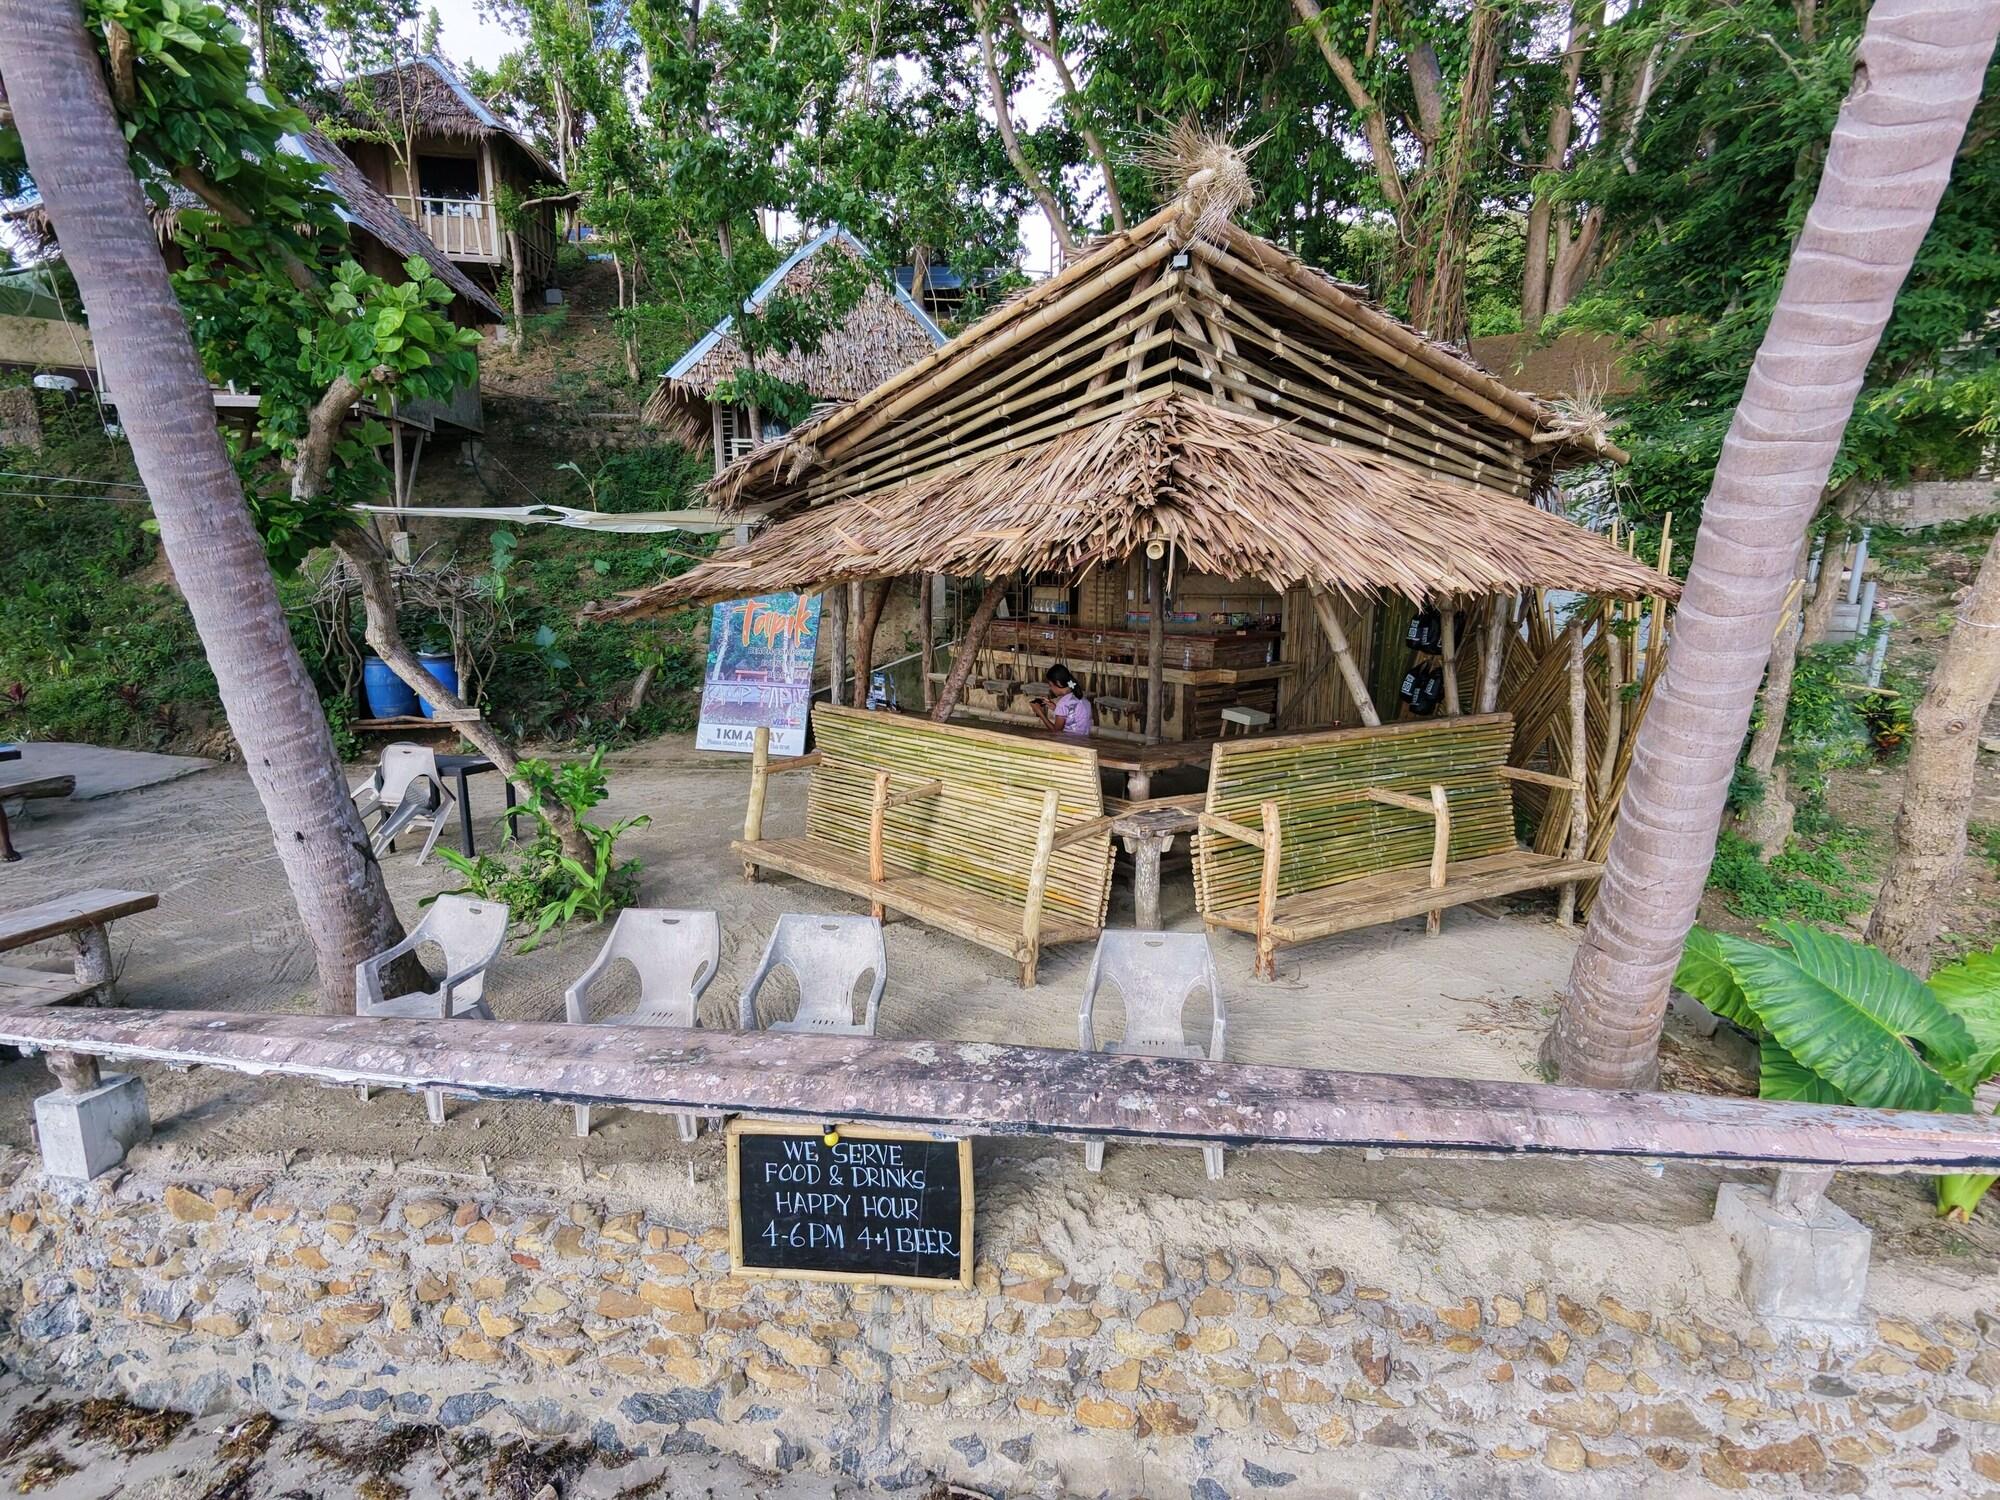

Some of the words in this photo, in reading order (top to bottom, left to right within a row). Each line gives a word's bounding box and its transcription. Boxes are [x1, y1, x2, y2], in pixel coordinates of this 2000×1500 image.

[732, 594, 812, 649] Tapik
[716, 728, 721, 739] 1
[723, 728, 743, 741] KM
[745, 730, 785, 744] AAY
[783, 1140, 819, 1162] WE
[832, 1143, 903, 1166] SERVE
[766, 1163, 821, 1185] FOOD
[829, 1166, 844, 1187] &
[851, 1167, 926, 1190] DRINKS
[776, 1192, 850, 1217] HAPPY
[863, 1196, 919, 1220] HOUR
[857, 1226, 891, 1251] 4+1
[896, 1227, 960, 1257] BEER
